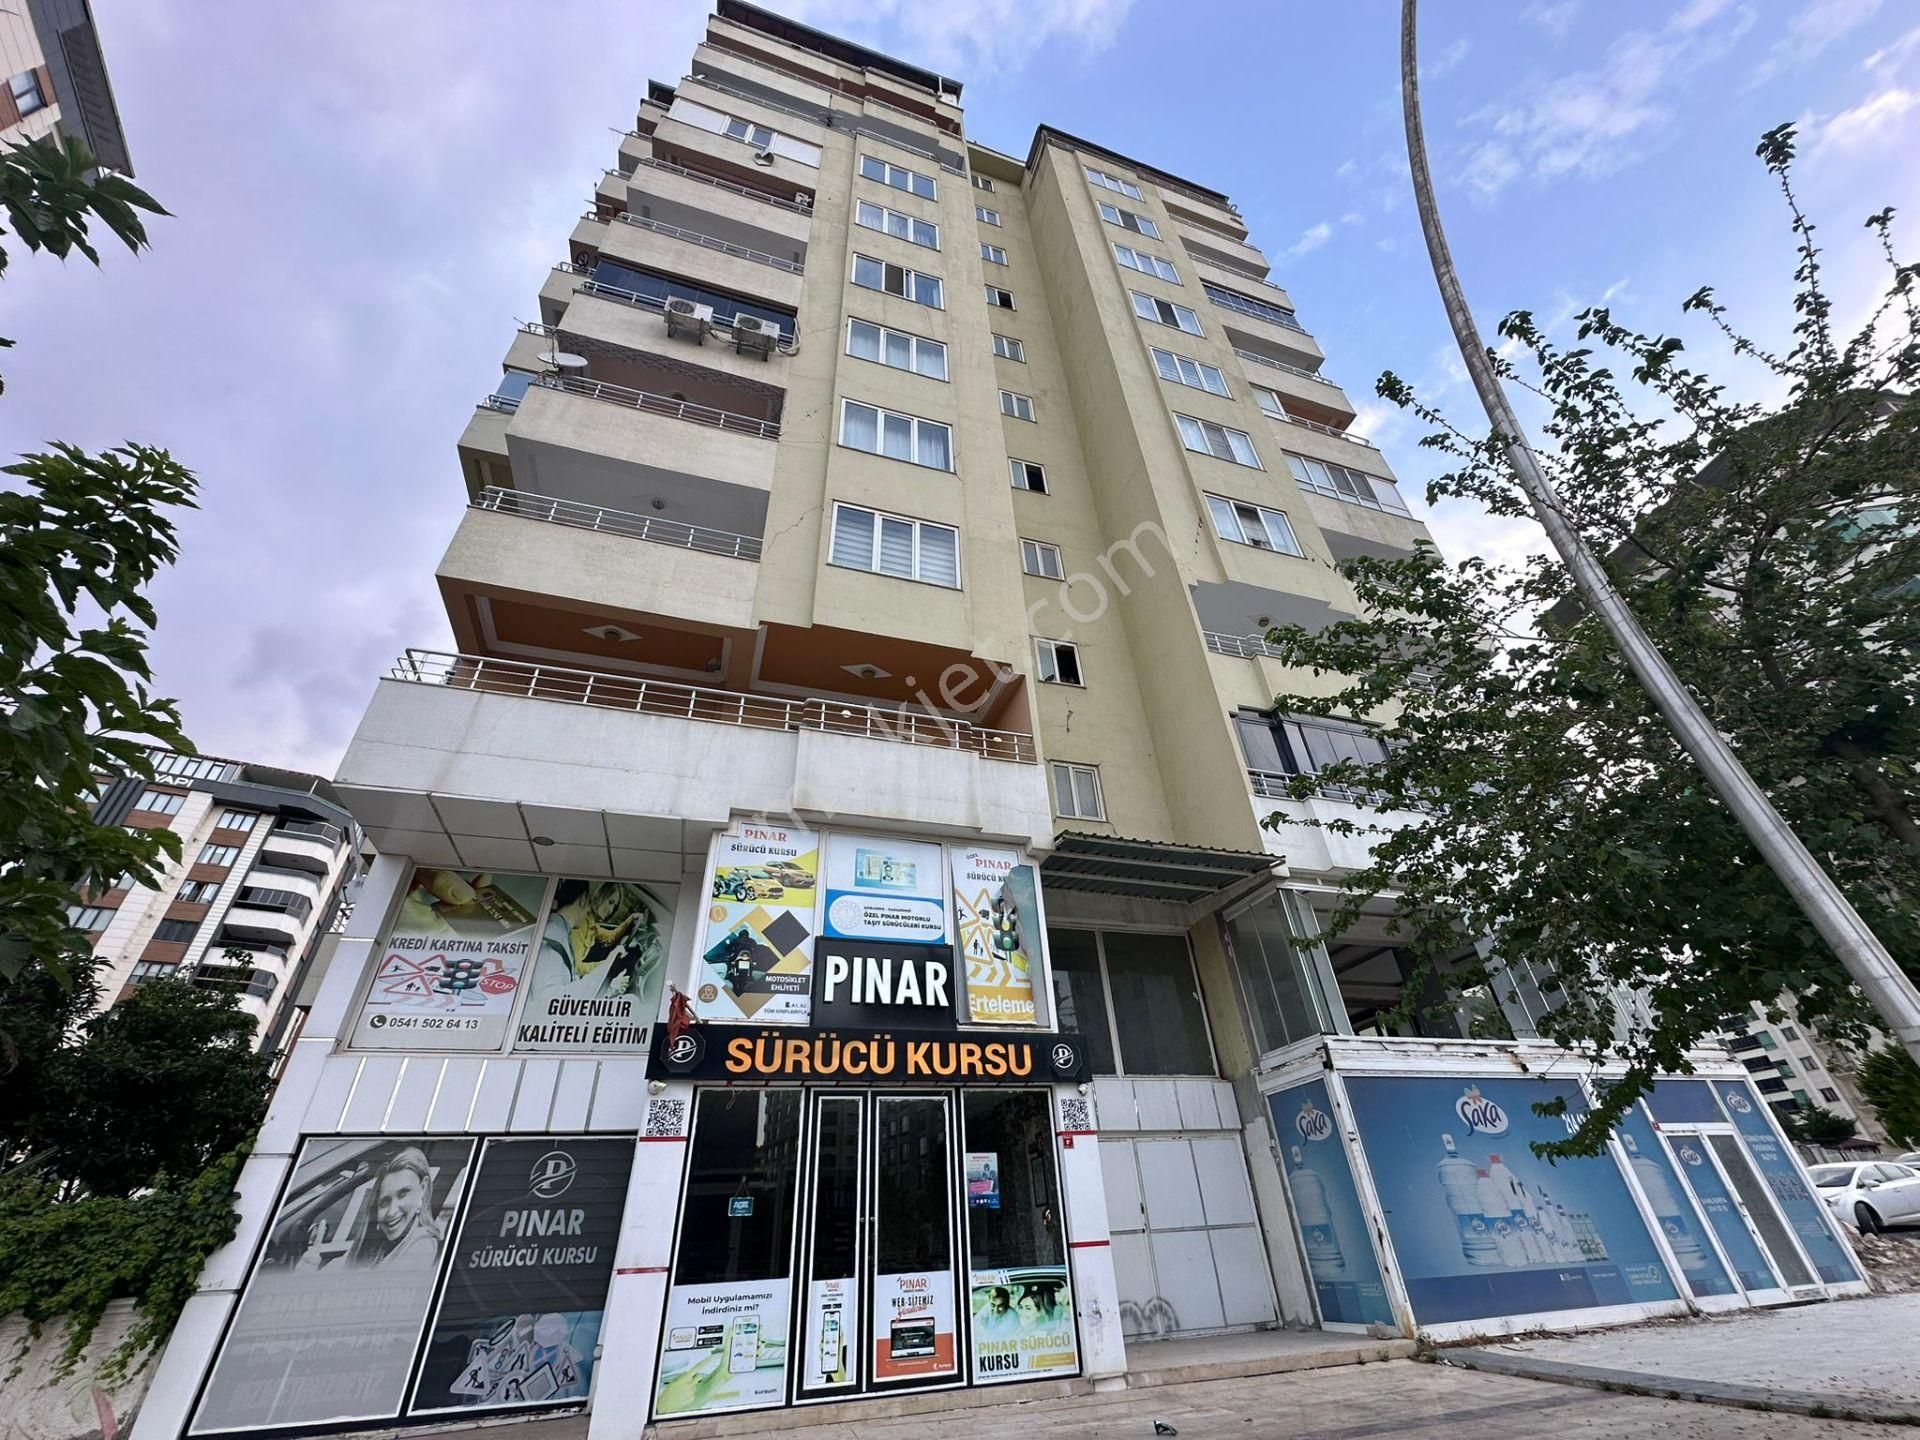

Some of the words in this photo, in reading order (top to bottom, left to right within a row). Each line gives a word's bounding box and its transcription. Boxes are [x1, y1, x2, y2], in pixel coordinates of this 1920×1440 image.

[744, 828, 787, 842] PINAR
[730, 842, 766, 854] SÜRÜCÜ
[768, 846, 797, 857] KURSU
[975, 858, 1011, 870] PINAR
[966, 871, 997, 882] SÜRÜCÜ
[388, 936, 428, 951] KREDİ
[429, 938, 484, 953] KARTINA
[481, 978, 514, 990] STOP
[824, 955, 950, 1008] PINAR
[547, 997, 632, 1018] GÜVENİLİR
[968, 993, 1035, 1013] Erteleme
[389, 1017, 420, 1029] 0541
[422, 1018, 443, 1029] 502
[445, 1019, 463, 1030] 64
[464, 1019, 478, 1030] 13
[518, 1021, 590, 1044] KALİTELİ
[592, 1021, 648, 1045] EĞİTİM
[725, 1031, 896, 1076] SÜRÜCÜ
[905, 1042, 1033, 1077] KURSU
[499, 1208, 585, 1237] PINAR
[469, 1244, 540, 1269] SÜRÜCÜ
[541, 1246, 598, 1266] KURSU
[900, 1278, 928, 1289] PINAR
[687, 1296, 712, 1305] Mobil
[713, 1293, 773, 1304] Uygulamamızı
[702, 1305, 742, 1315] İndirdiniz
[744, 1304, 760, 1312] mi?
[978, 1340, 1018, 1355] PINAR
[1020, 1332, 1071, 1351] SÜRÜCÜ
[979, 1353, 1020, 1373] KURSU
